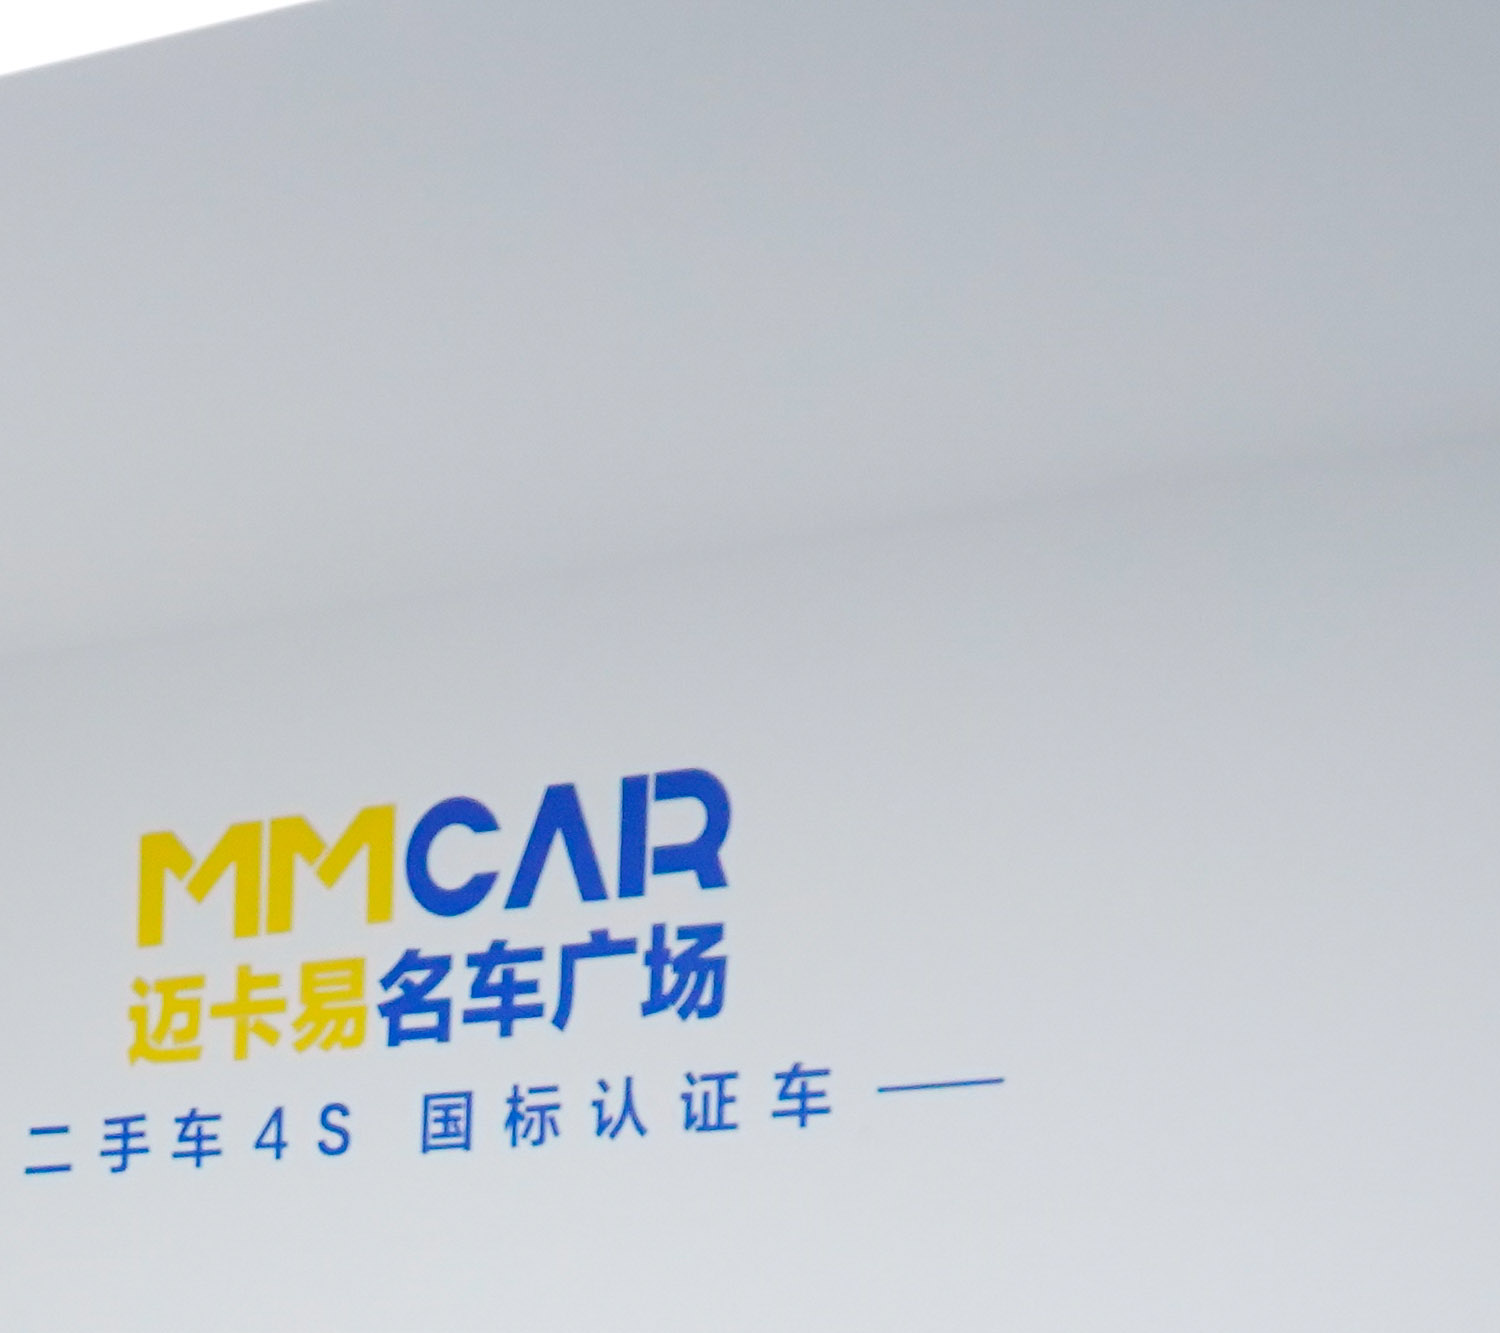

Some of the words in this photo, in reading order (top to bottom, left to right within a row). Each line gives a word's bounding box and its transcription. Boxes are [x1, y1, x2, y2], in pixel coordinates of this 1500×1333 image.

[138, 768, 731, 948] MMCAR
[128, 922, 728, 1065] 迈卡易名车广场
[421, 1062, 832, 1154] 国标认证车
